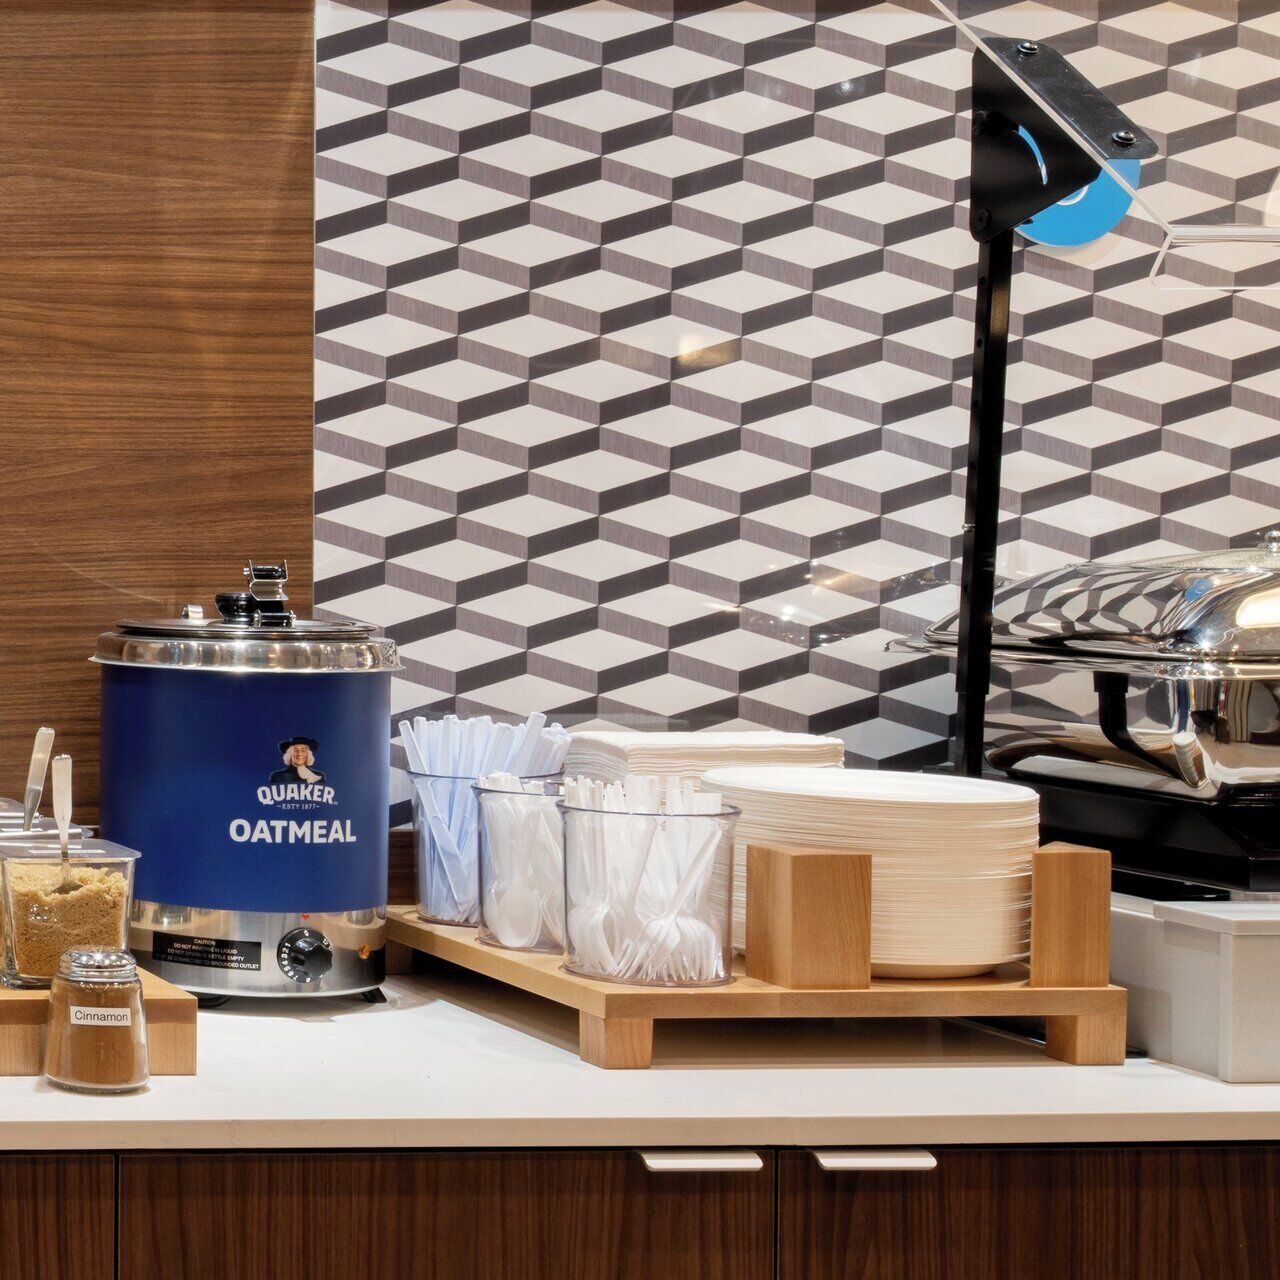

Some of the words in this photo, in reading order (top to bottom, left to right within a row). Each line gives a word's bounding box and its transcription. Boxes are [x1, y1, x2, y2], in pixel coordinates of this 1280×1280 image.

[256, 783, 335, 805] QUAKER
[229, 818, 357, 844] OATMEAL
[193, 938, 216, 946] CAUTION
[210, 960, 239, 968] GROUNDED
[74, 1010, 128, 1022] Cinnamon
